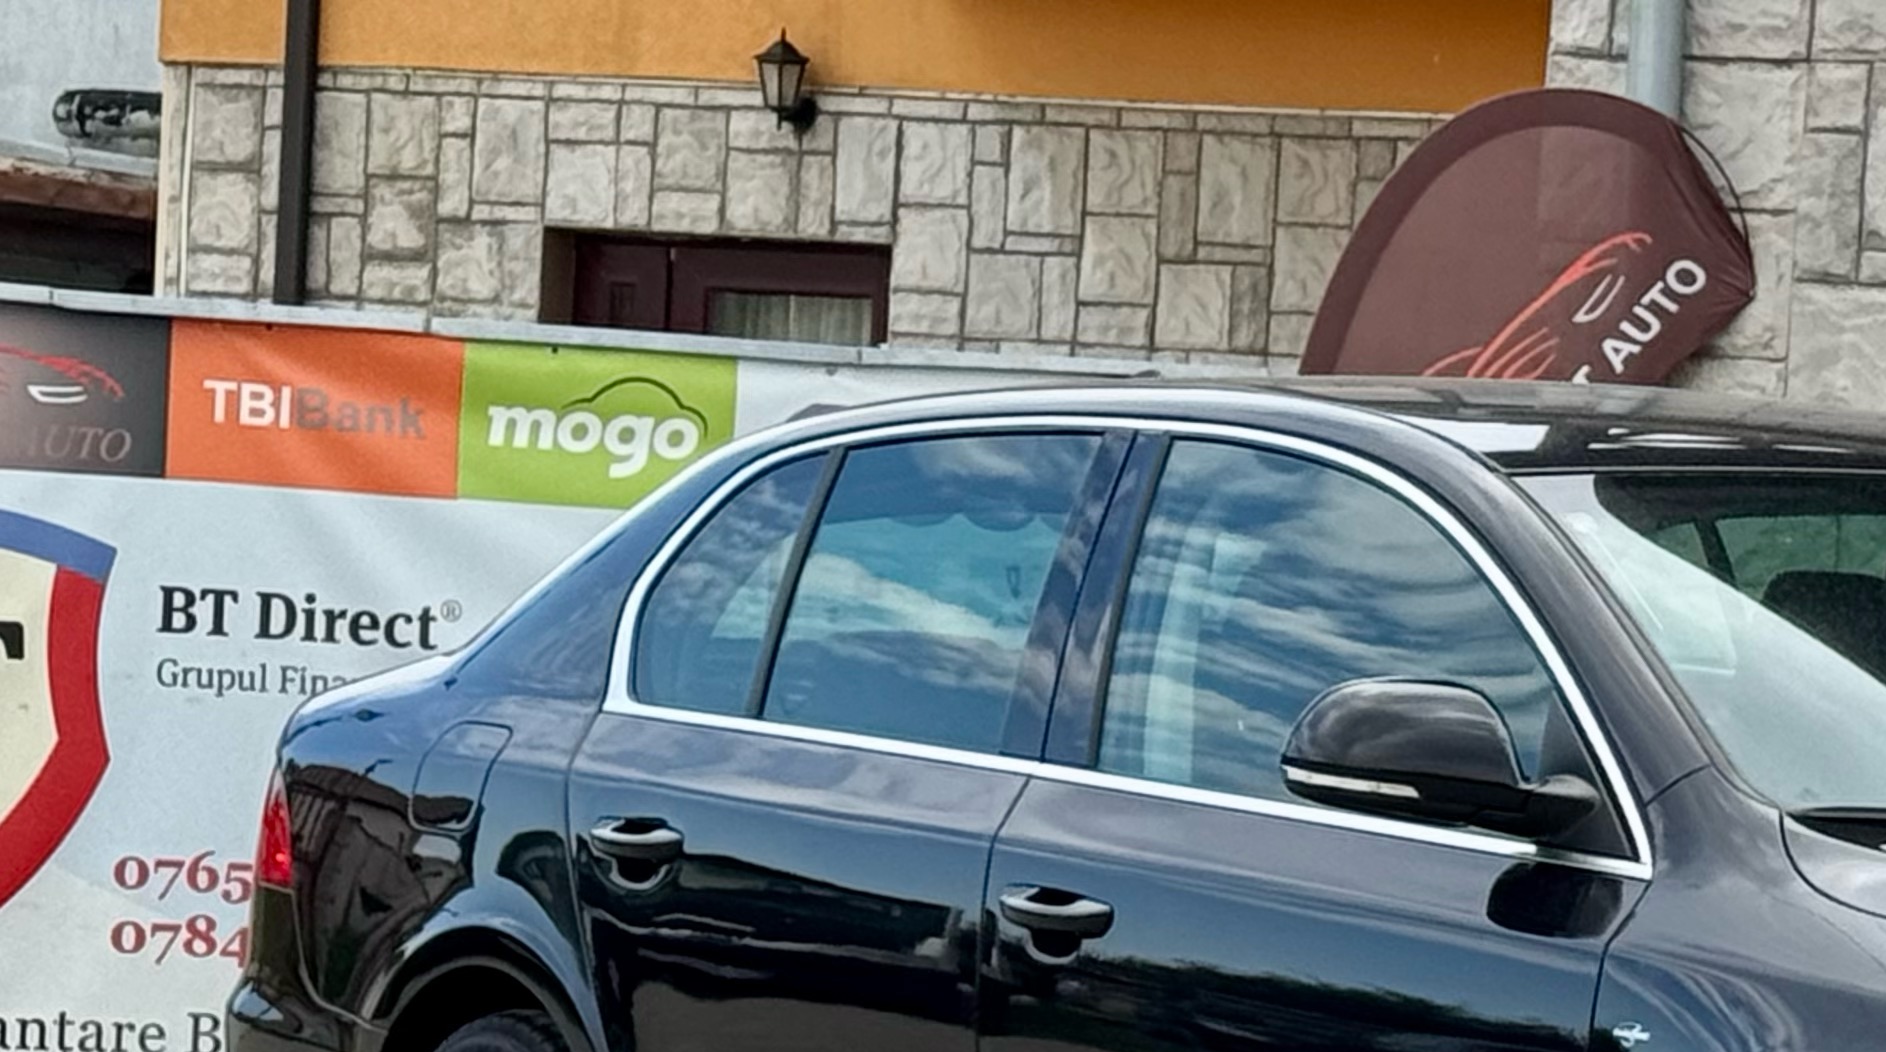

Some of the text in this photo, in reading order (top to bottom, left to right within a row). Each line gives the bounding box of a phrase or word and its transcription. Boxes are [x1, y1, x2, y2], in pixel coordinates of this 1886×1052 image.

[1601, 259, 1707, 375] AUTO
[203, 378, 427, 442] TBIBank
[487, 403, 700, 480] mogo
[156, 584, 240, 638] BT
[156, 657, 269, 699] Grupul
[113, 850, 253, 905] 0765
[110, 913, 249, 969] 0784
